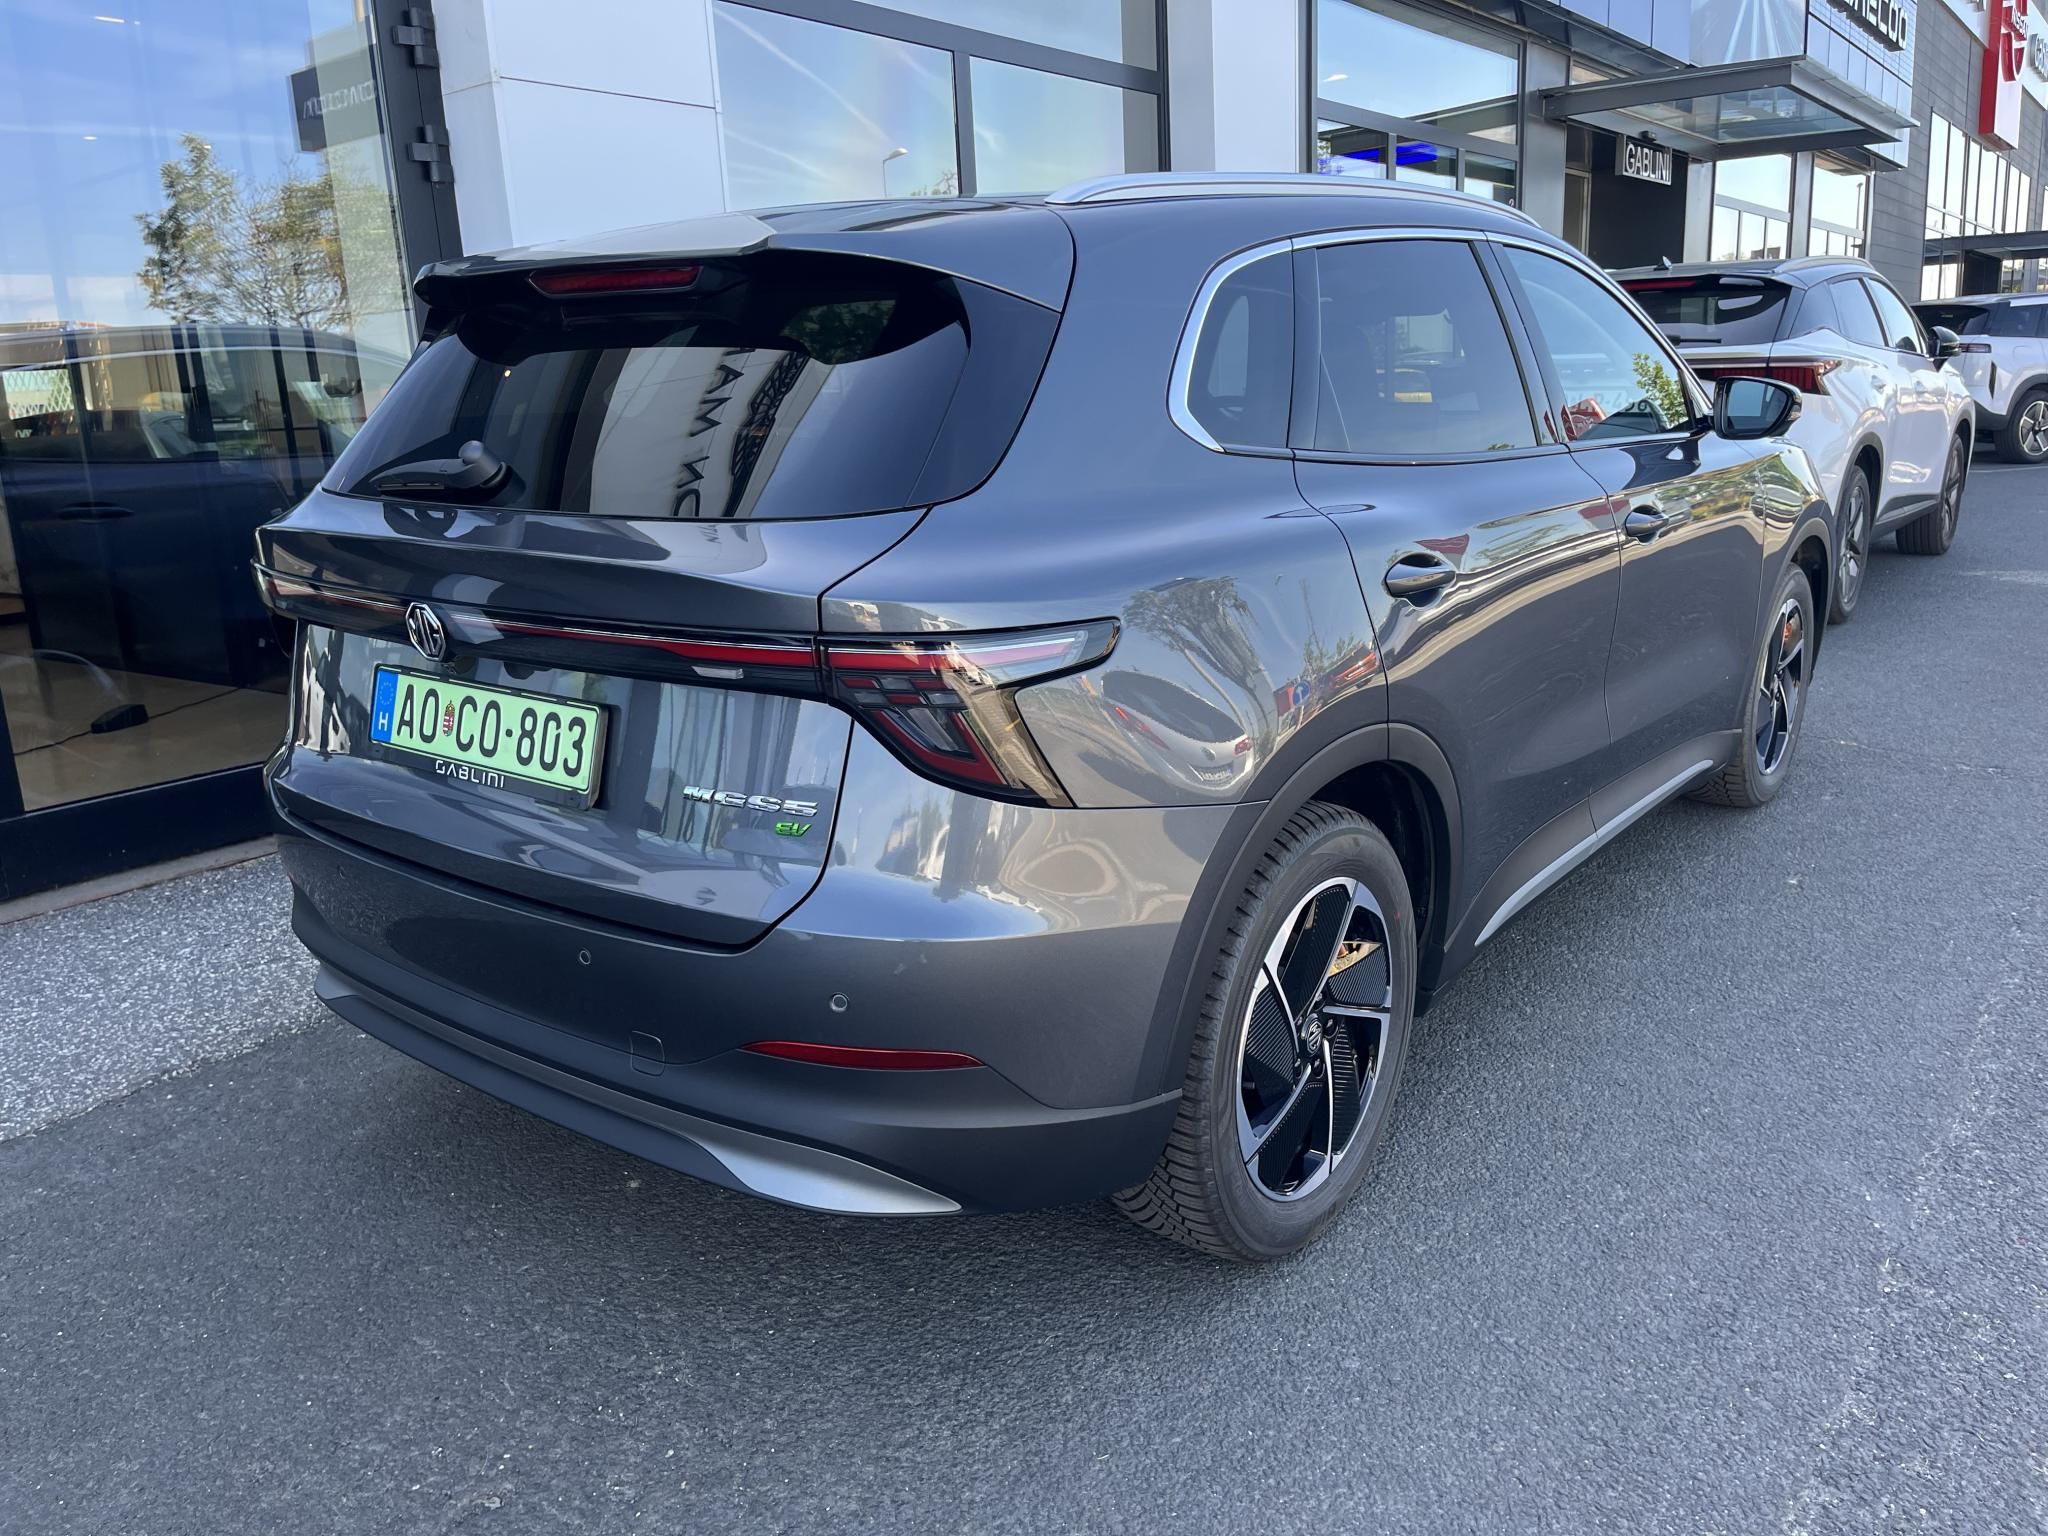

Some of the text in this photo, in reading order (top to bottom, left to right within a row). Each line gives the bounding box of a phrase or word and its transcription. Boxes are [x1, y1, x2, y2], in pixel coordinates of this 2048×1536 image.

[1626, 143, 1671, 182] GABLINI
[378, 711, 389, 732] H
[435, 759, 505, 788] GABLINI
[682, 785, 818, 818] MGS5
[774, 821, 812, 837] EV
